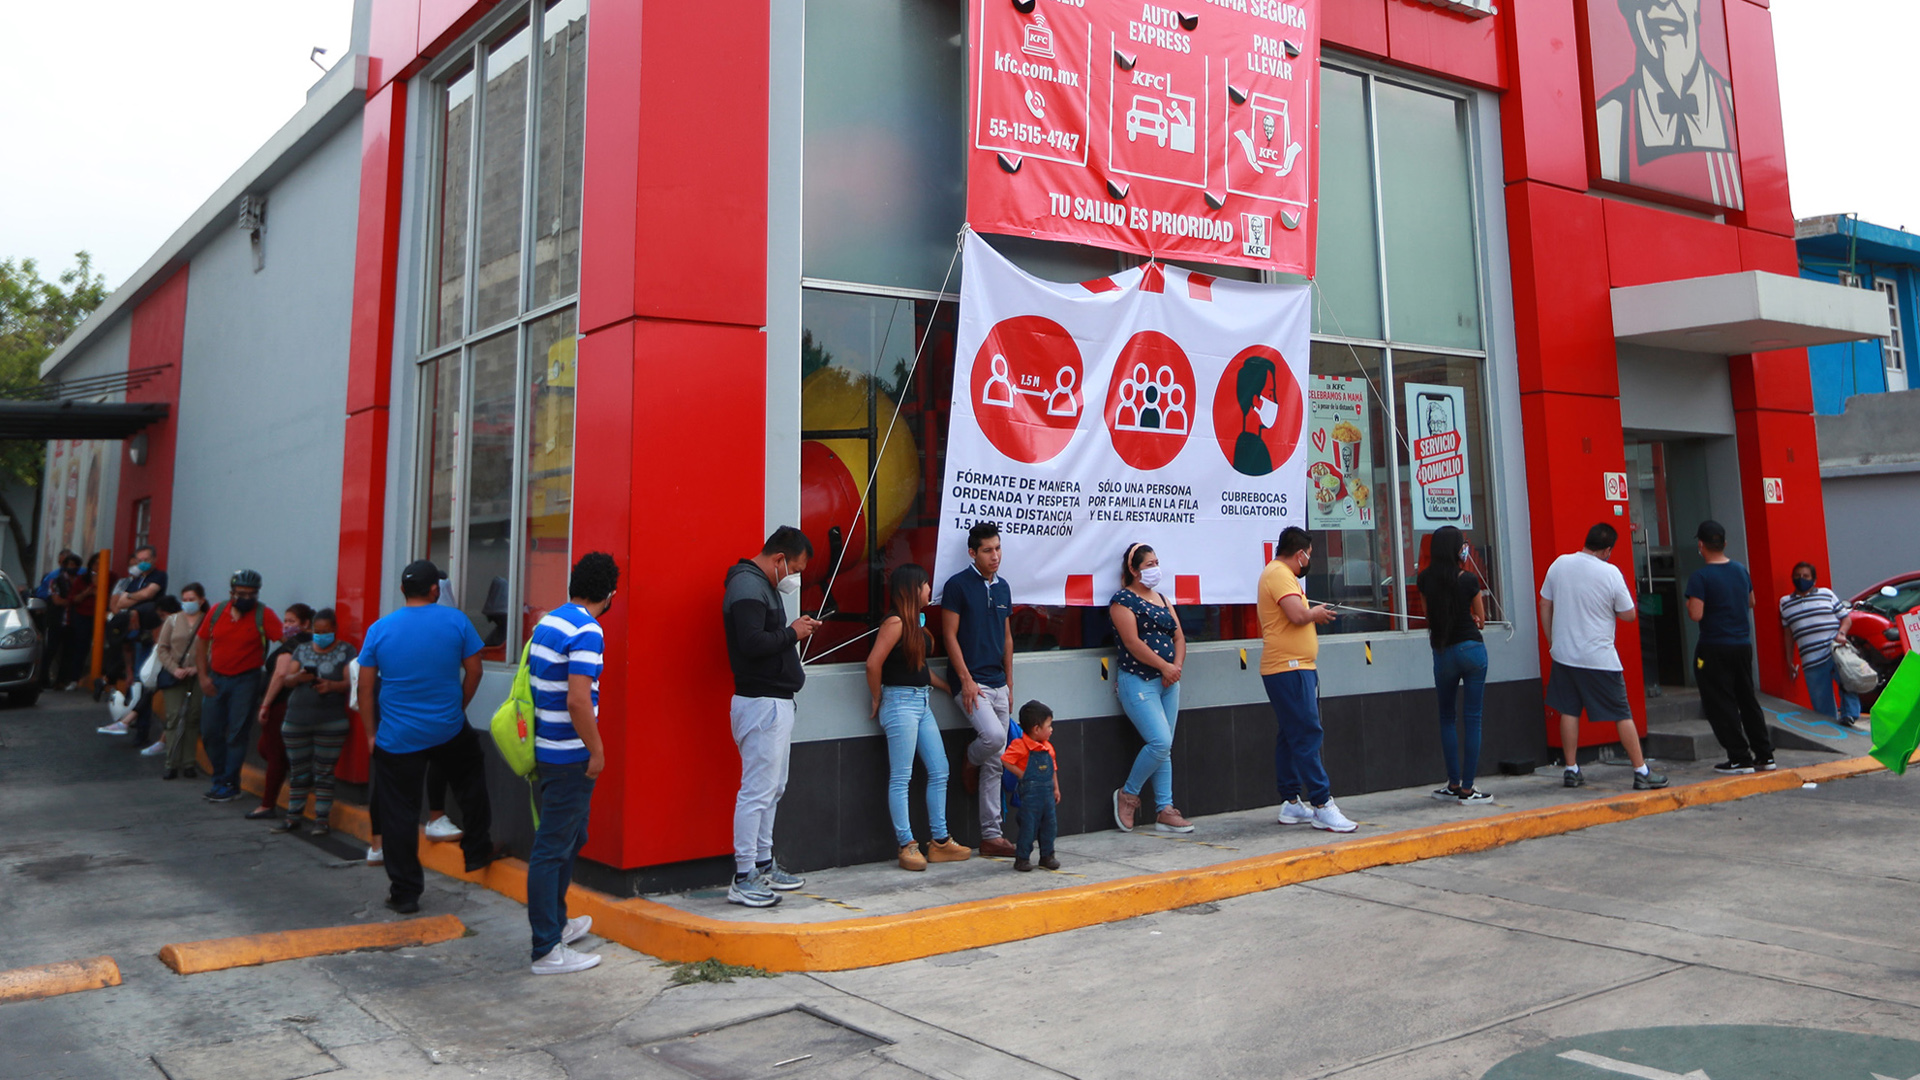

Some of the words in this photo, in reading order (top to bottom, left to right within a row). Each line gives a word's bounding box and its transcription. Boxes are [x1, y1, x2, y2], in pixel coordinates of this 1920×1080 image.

[1141, 3, 1179, 30] AUTO
[1250, 0, 1306, 30] SEGURA
[1029, 34, 1048, 45] KFC
[1129, 20, 1191, 54] EXPRESS
[1253, 34, 1286, 60] PARA
[994, 51, 1080, 88] kfc.com.mx
[1247, 52, 1293, 81] LLEVAR
[1131, 70, 1166, 90] KFC
[990, 118, 1080, 152] 55-1515-4747
[1258, 146, 1278, 161] KFC
[1049, 192, 1072, 218] TU
[1074, 199, 1126, 227] SALUD
[1130, 206, 1148, 232] ES
[1152, 210, 1234, 243] PRIORIDAD
[1246, 244, 1268, 257] KFC
[1020, 373, 1032, 386] 1.5
[1032, 376, 1040, 388] M
[1348, 391, 1363, 402] MAMÁ
[1420, 433, 1456, 457] SERVICIO
[956, 468, 1017, 488] FÓRMATE
[1020, 478, 1036, 490] DE
[1039, 480, 1080, 492] MANERA
[1422, 458, 1460, 484] DOMICILIO
[952, 486, 1022, 504] ORDENADA
[1027, 494, 1034, 504] Y
[1038, 494, 1080, 508] RESPETA
[1098, 479, 1122, 493] SÓLO
[1124, 483, 1144, 494] UNA
[1146, 484, 1192, 496] PERSONA
[1221, 491, 1287, 504] CUBREBOCAS
[960, 502, 976, 515] LA
[980, 504, 1012, 518] SANA
[1016, 508, 1072, 522] DISTANCIA
[1088, 496, 1106, 506] POR
[1109, 496, 1146, 508] FAMILIA
[1149, 498, 1162, 508] EN
[1164, 499, 1176, 510] LA
[1178, 500, 1198, 510] FILA
[1220, 504, 1288, 517] OBLIGATORIO
[954, 518, 971, 530] 1.5
[1006, 522, 1073, 536] SEPARACIÓN
[1089, 510, 1096, 520] Y
[1098, 510, 1111, 521] EN
[1114, 510, 1123, 521] EL
[1126, 511, 1195, 524] RESTAURANTE
